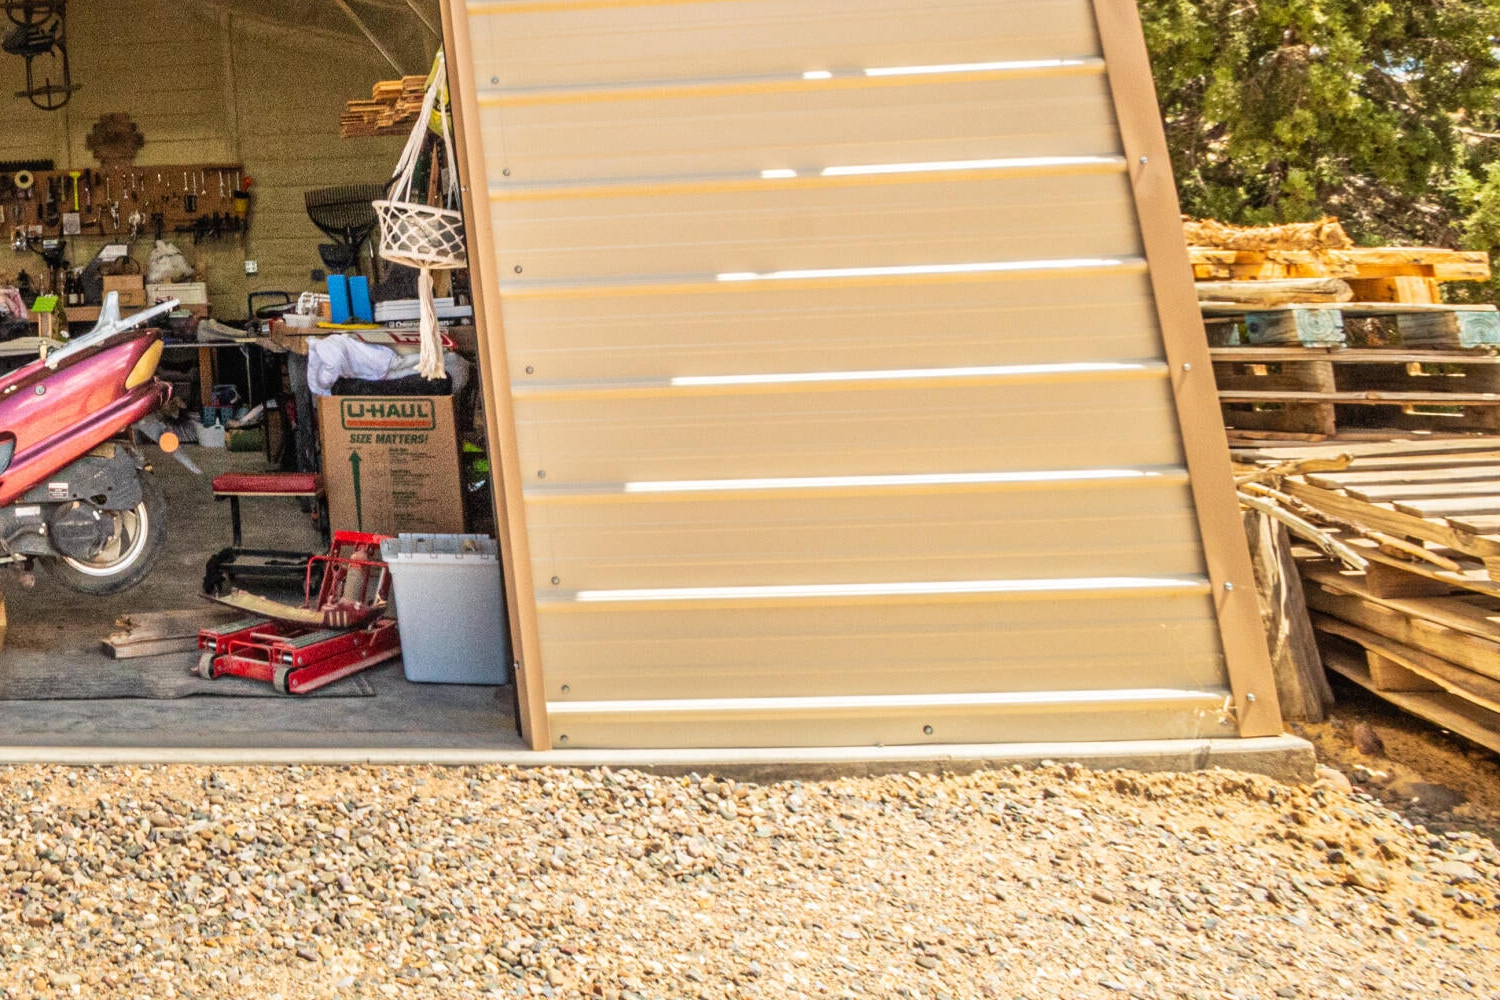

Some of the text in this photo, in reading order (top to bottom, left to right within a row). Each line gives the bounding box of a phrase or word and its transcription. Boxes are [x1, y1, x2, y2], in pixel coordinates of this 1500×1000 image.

[347, 403, 429, 418] U-HAUL
[350, 433, 429, 445] SIZE MATTERS!
